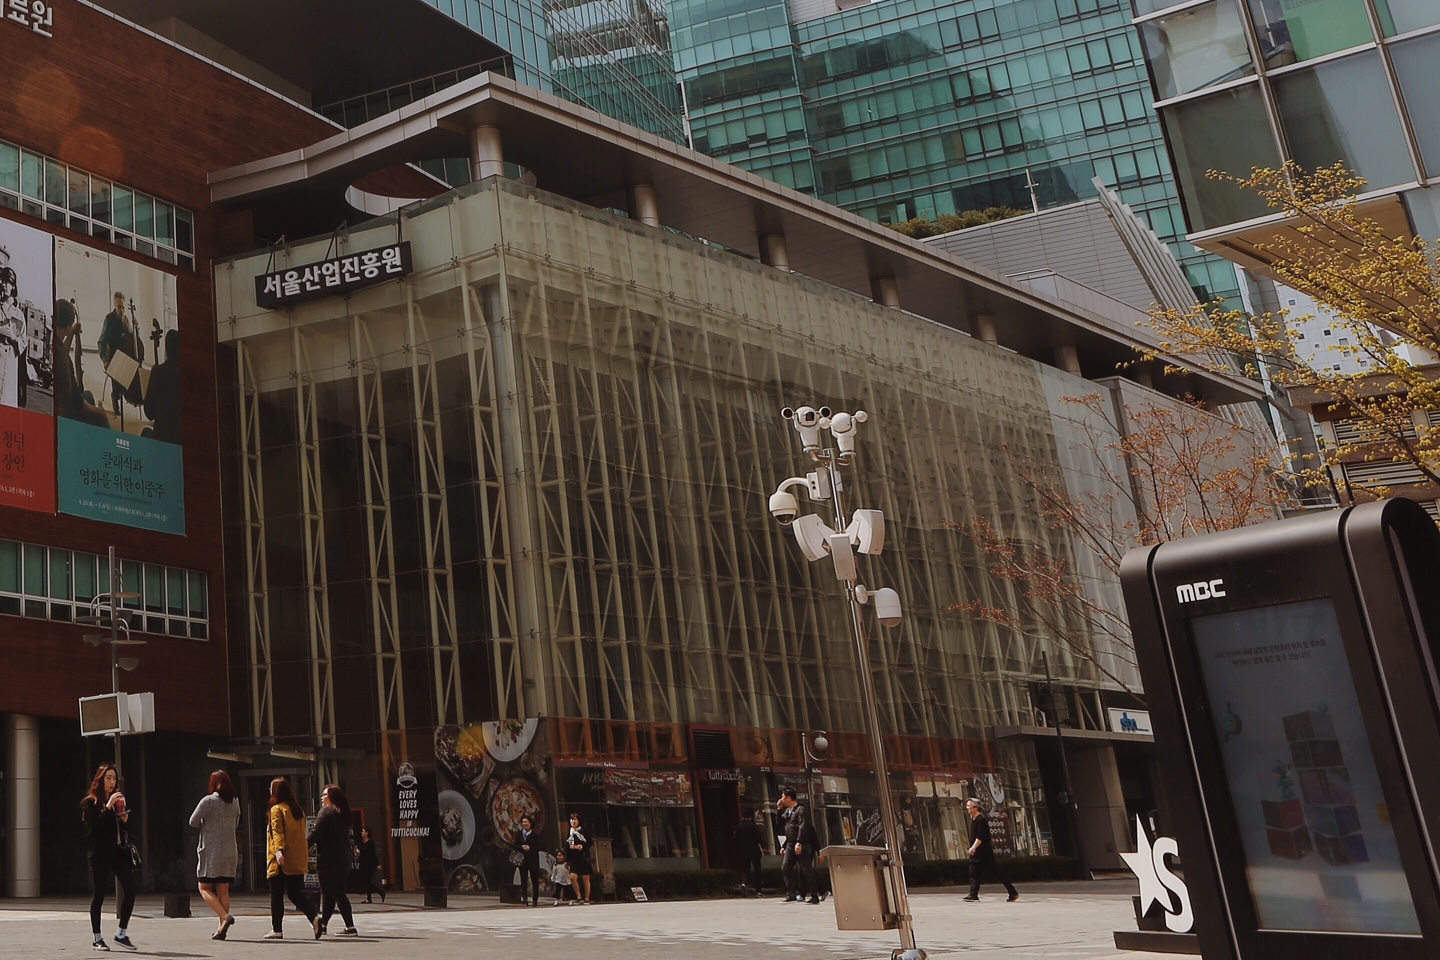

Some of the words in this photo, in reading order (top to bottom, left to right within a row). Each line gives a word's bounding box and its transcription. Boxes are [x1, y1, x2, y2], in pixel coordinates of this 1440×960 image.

[263, 246, 403, 299] 서울산업진흥원
[3, 430, 25, 451] 청년
[3, 453, 25, 473] 장인
[102, 451, 143, 475] 클래식과
[80, 468, 111, 490] 영화를
[1176, 578, 1227, 604] MBC
[398, 789, 418, 799] EVERY
[399, 799, 417, 809] LOVES
[399, 809, 419, 819] HAPPY
